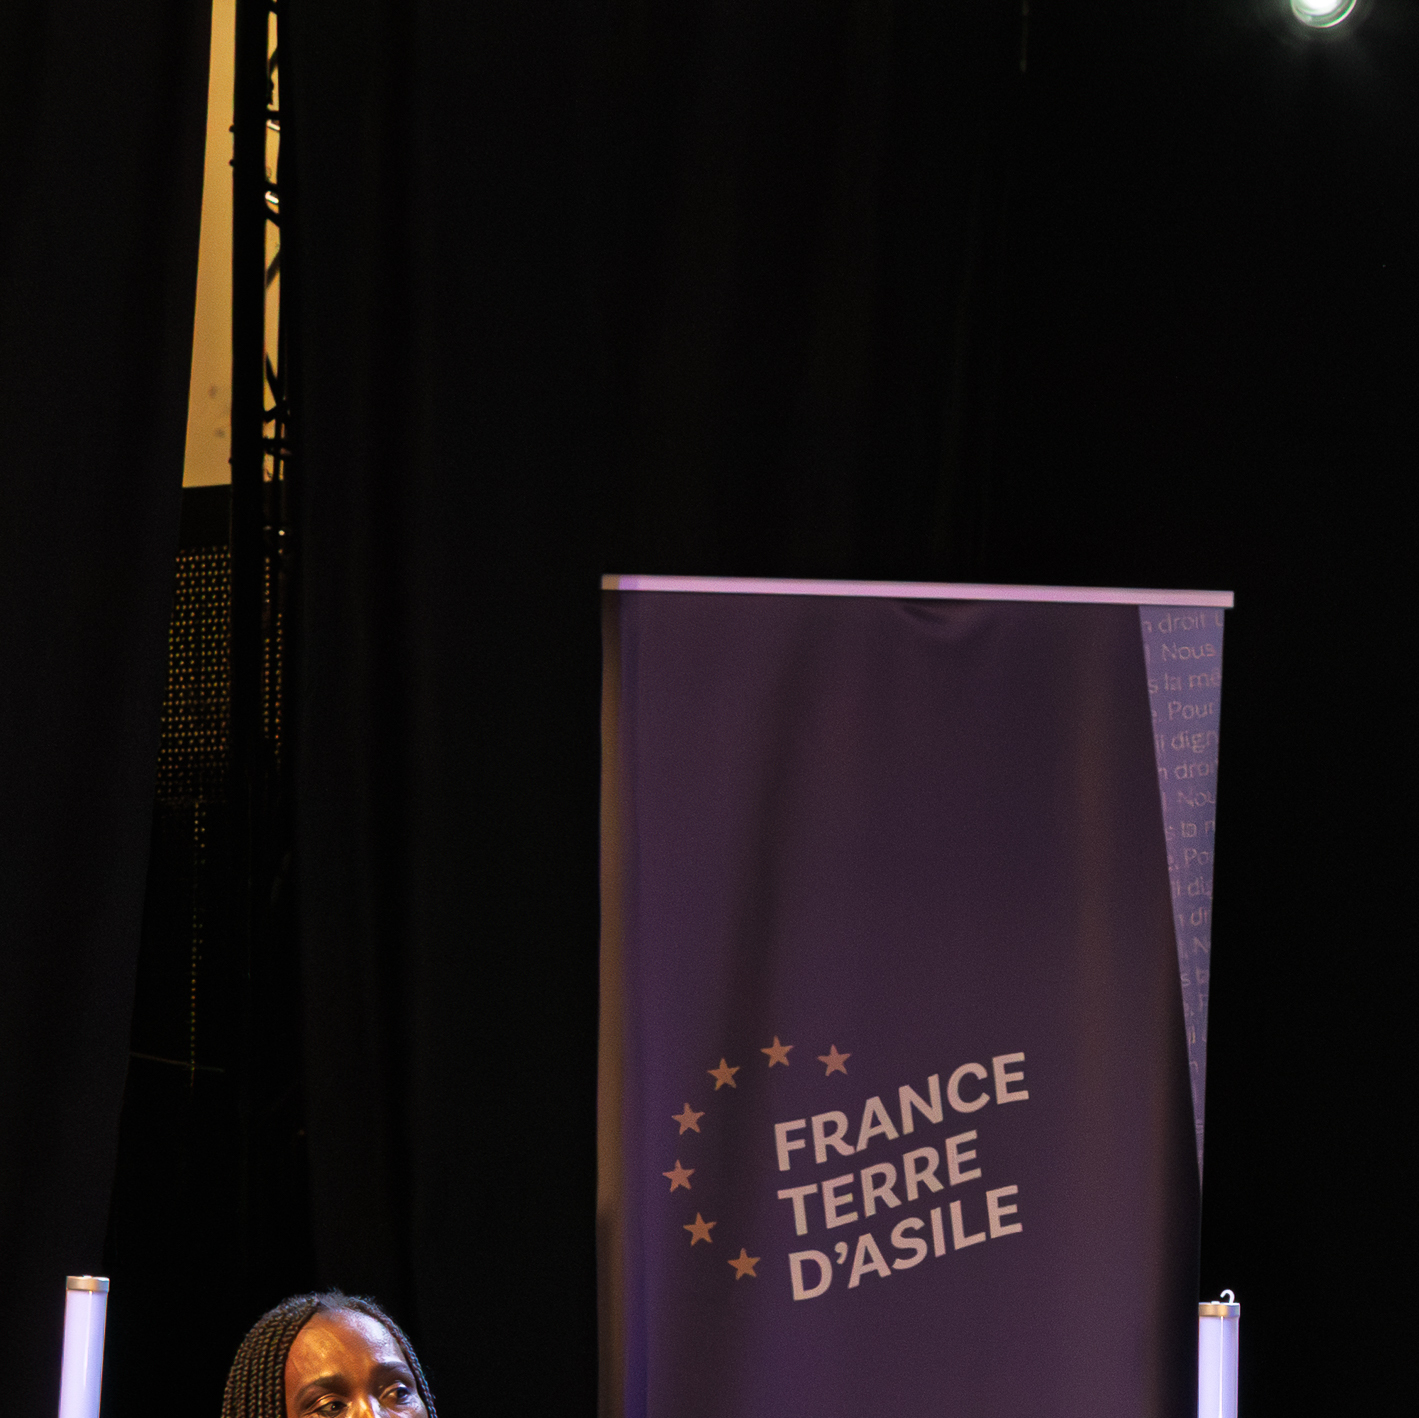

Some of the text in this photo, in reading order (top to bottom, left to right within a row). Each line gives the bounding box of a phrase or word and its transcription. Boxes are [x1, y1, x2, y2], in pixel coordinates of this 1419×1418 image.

[1171, 729, 1218, 753] dign
[774, 1052, 1029, 1171] FRANCE
[777, 1129, 982, 1236] TERRE
[789, 1184, 1023, 1301] D'ASILE
